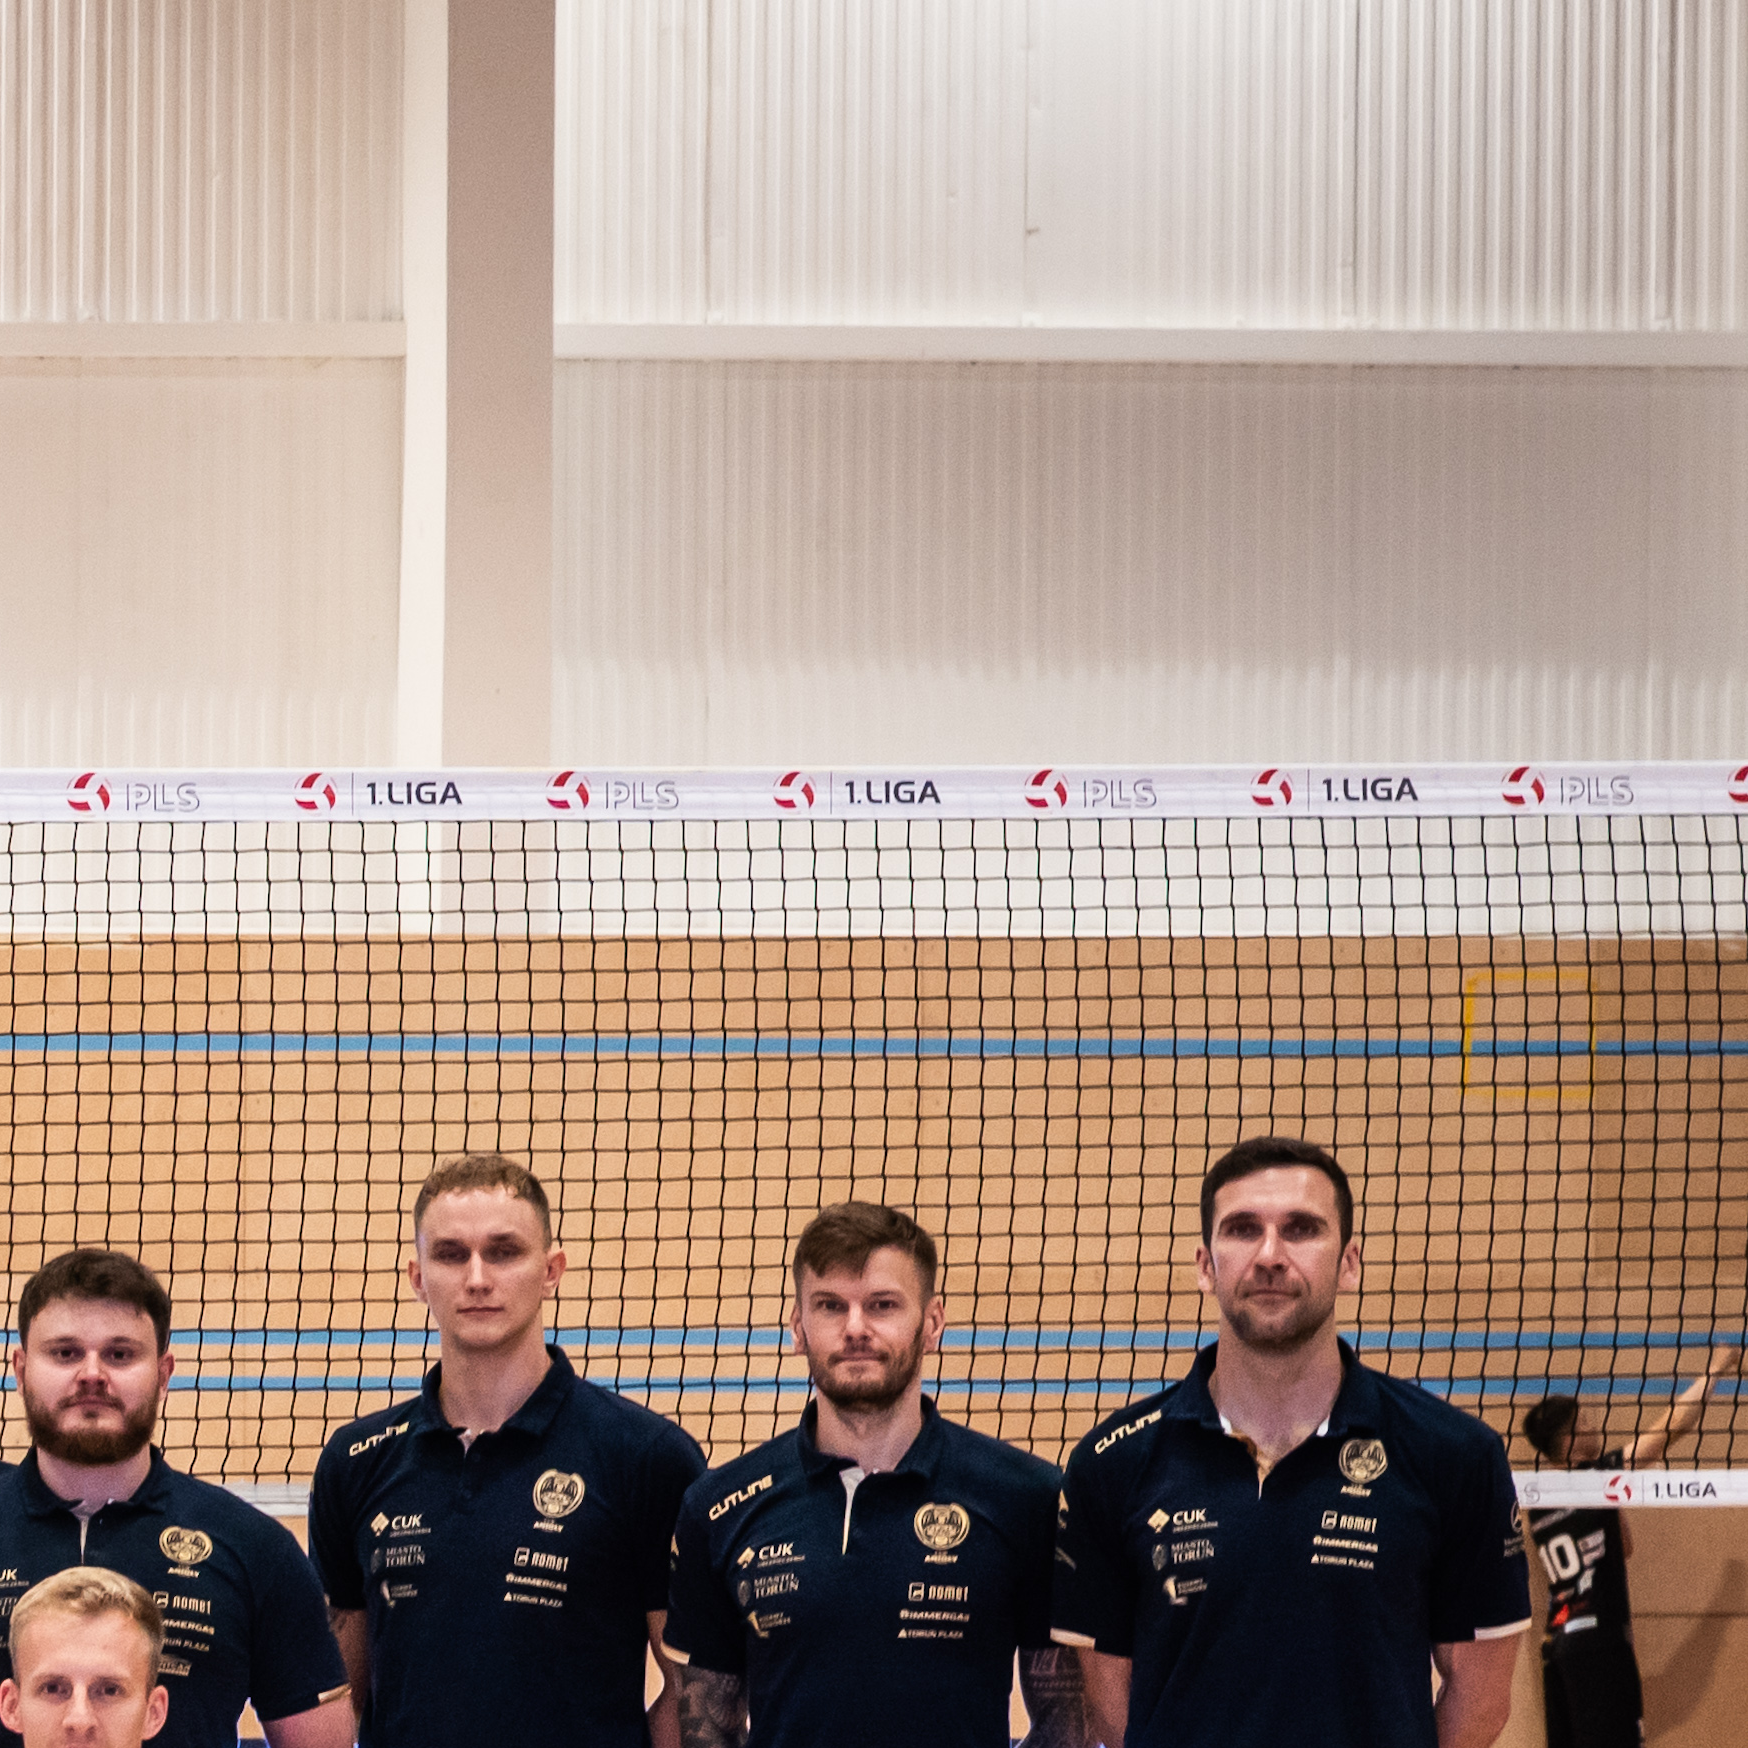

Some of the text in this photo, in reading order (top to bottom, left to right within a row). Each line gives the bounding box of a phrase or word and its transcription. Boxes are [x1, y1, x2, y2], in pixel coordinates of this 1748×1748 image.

[1095, 1409, 1162, 1455] CUTLINE
[391, 1514, 423, 1532] CUK
[1173, 1508, 1208, 1528] CUK
[759, 1543, 794, 1562] CUK
